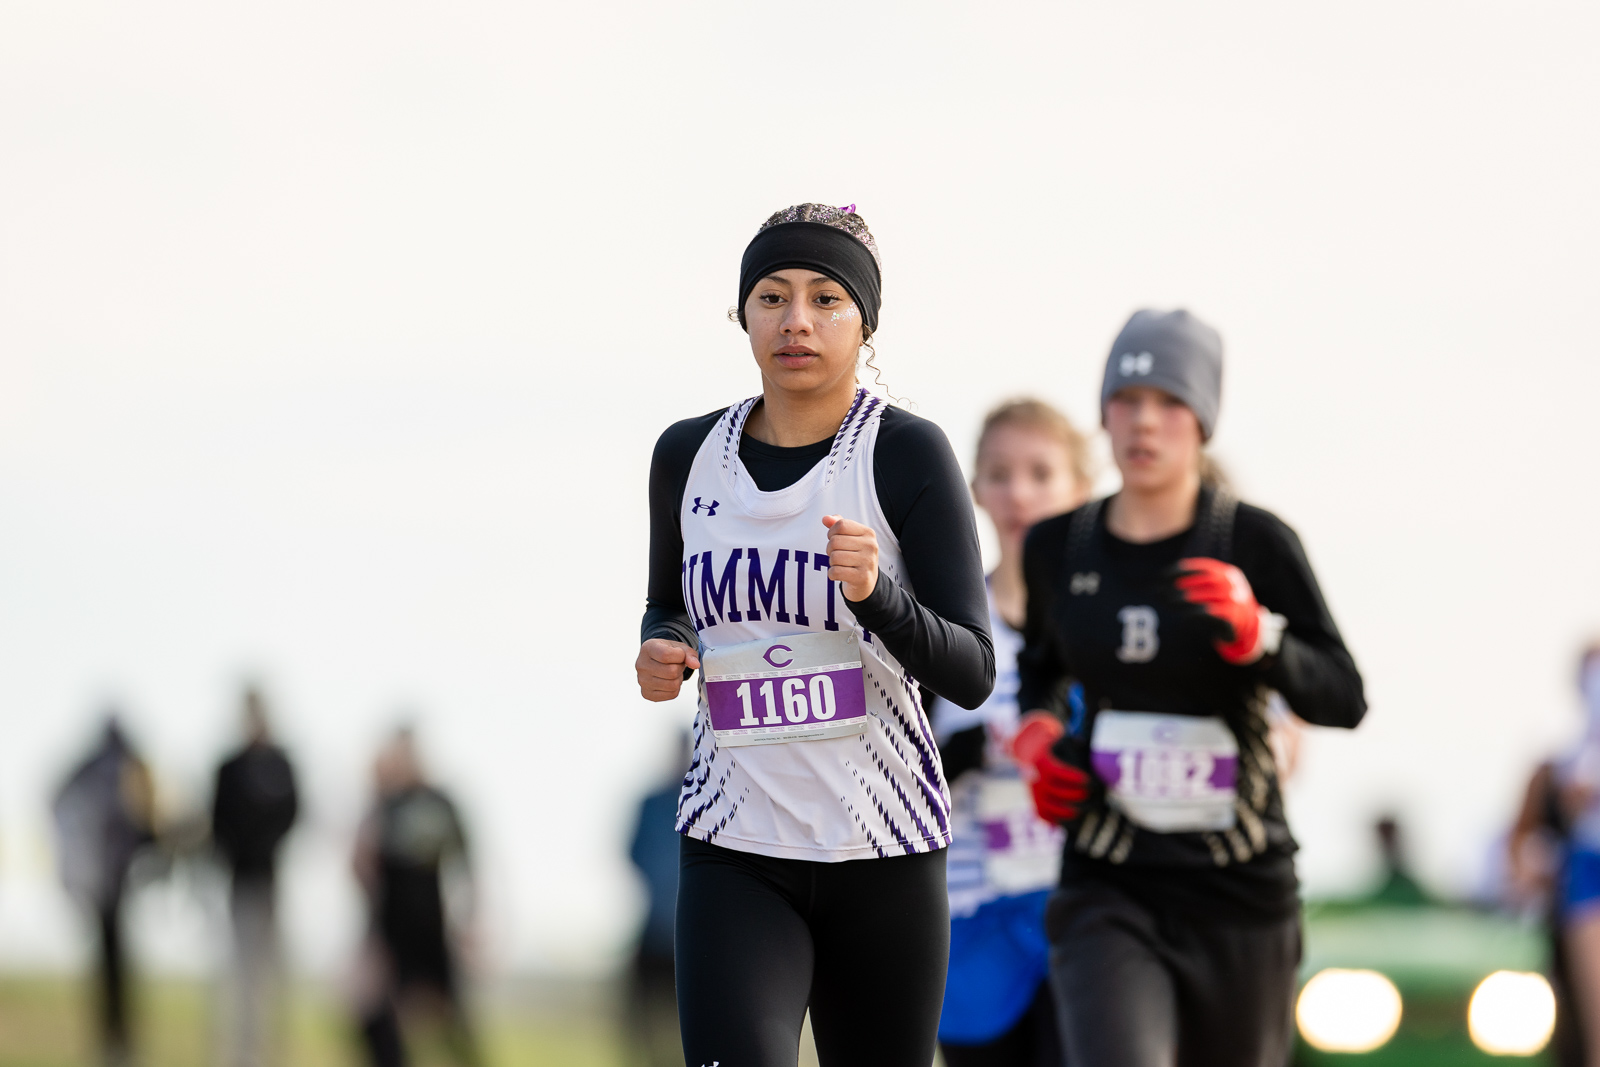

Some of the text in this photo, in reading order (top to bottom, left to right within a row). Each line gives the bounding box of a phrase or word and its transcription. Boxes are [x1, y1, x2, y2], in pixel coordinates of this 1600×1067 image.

[762, 644, 793, 668] C
[1116, 605, 1160, 664] B
[736, 674, 836, 727] 1160
